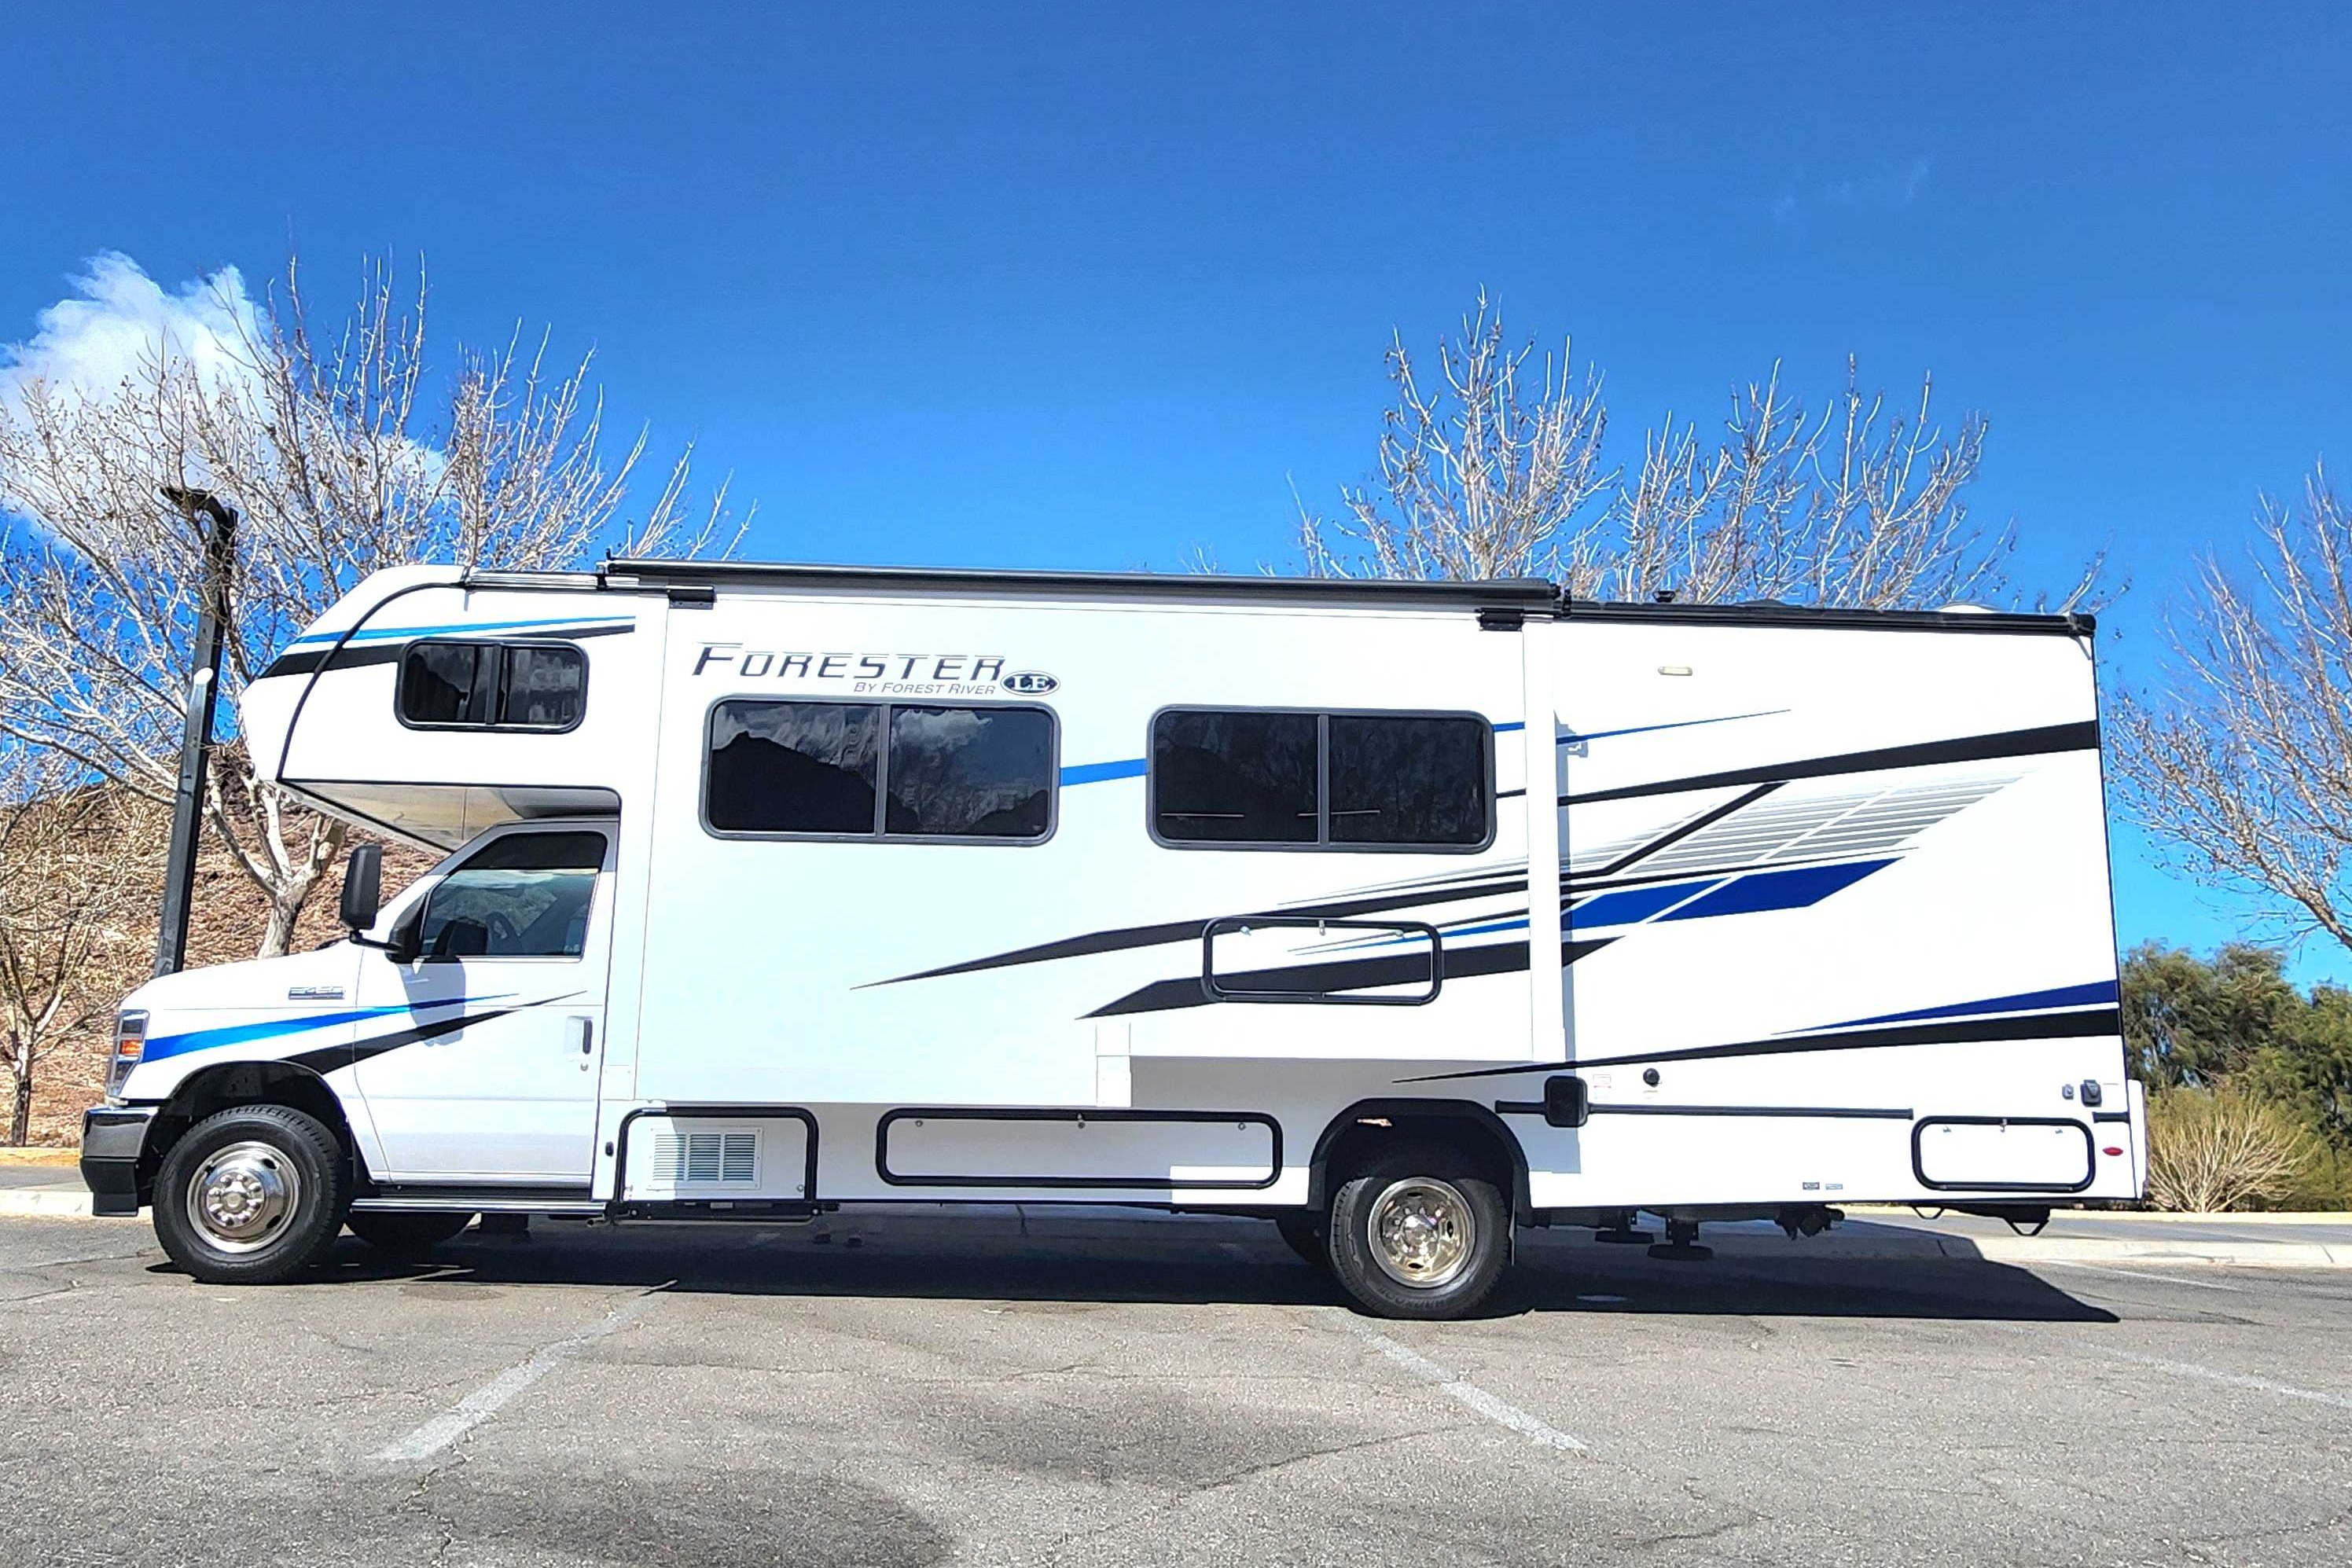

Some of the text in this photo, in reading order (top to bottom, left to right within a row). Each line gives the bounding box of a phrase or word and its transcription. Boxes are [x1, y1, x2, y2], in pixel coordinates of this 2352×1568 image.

[692, 641, 1005, 681] FORESTER
[854, 681, 996, 695] BY FOREST RIVER
[1012, 674, 1050, 692] LE
